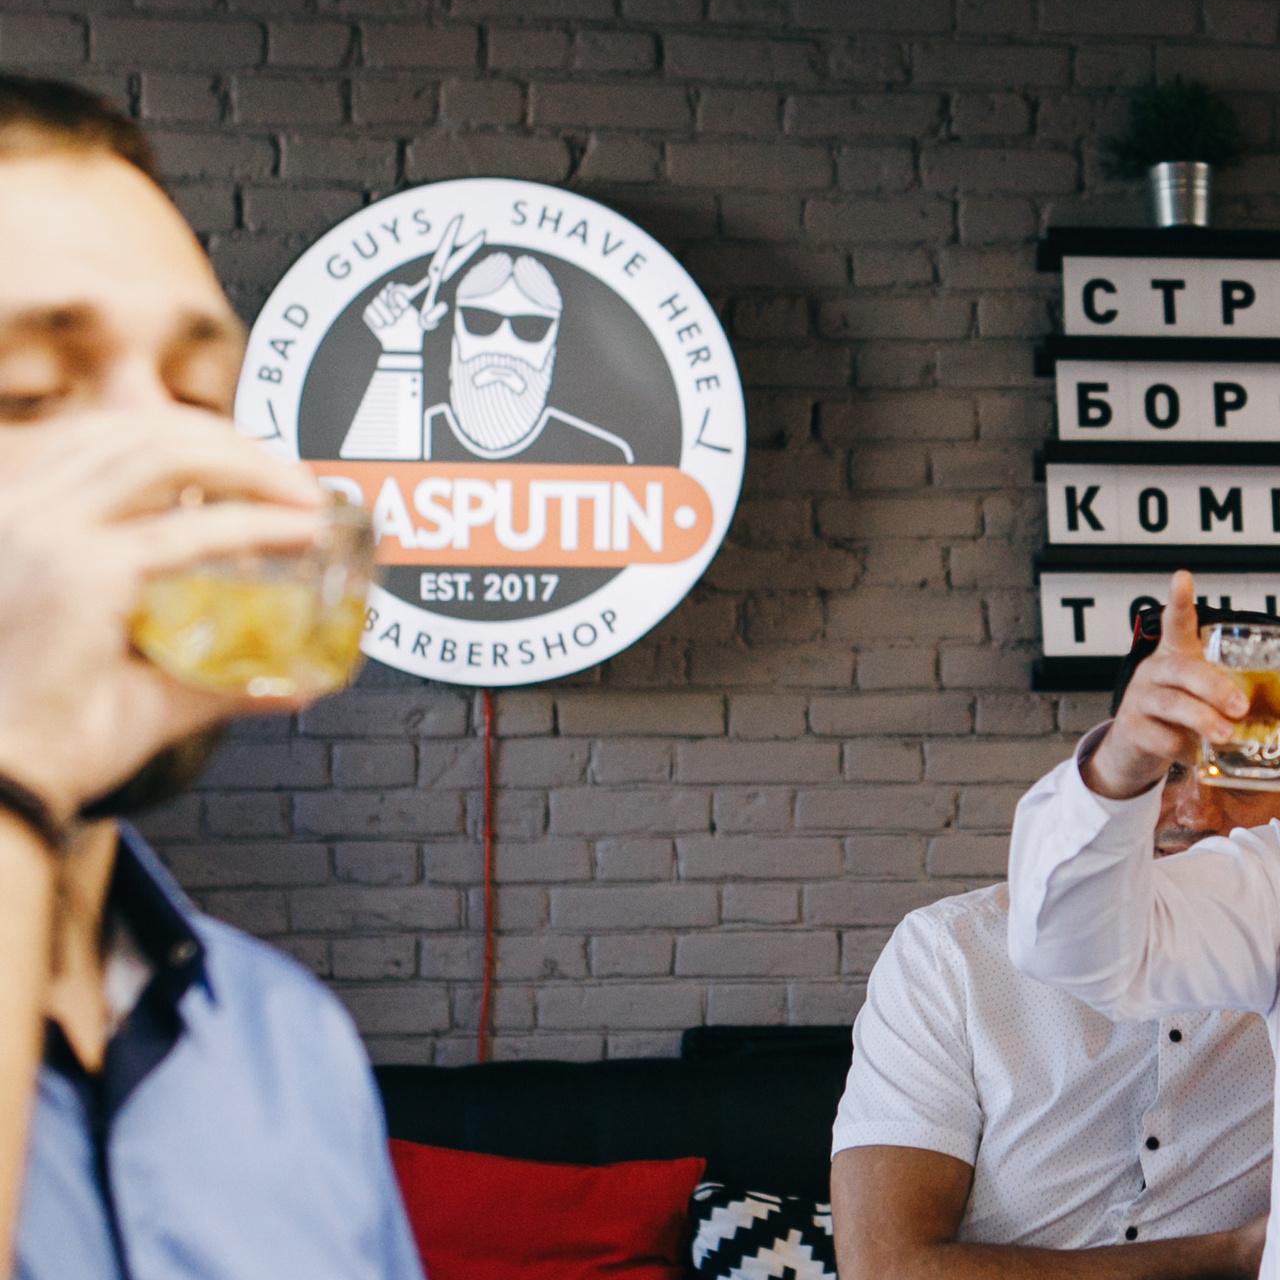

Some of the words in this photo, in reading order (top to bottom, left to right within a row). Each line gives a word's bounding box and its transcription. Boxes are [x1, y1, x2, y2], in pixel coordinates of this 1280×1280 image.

[258, 303, 309, 384] BAD
[326, 209, 432, 280] GUYS
[511, 200, 647, 277] SHAVE
[659, 293, 720, 392] HERE
[420, 572, 474, 602] EST.
[484, 574, 560, 602] 2017
[364, 606, 618, 667] BARBERSHOP
